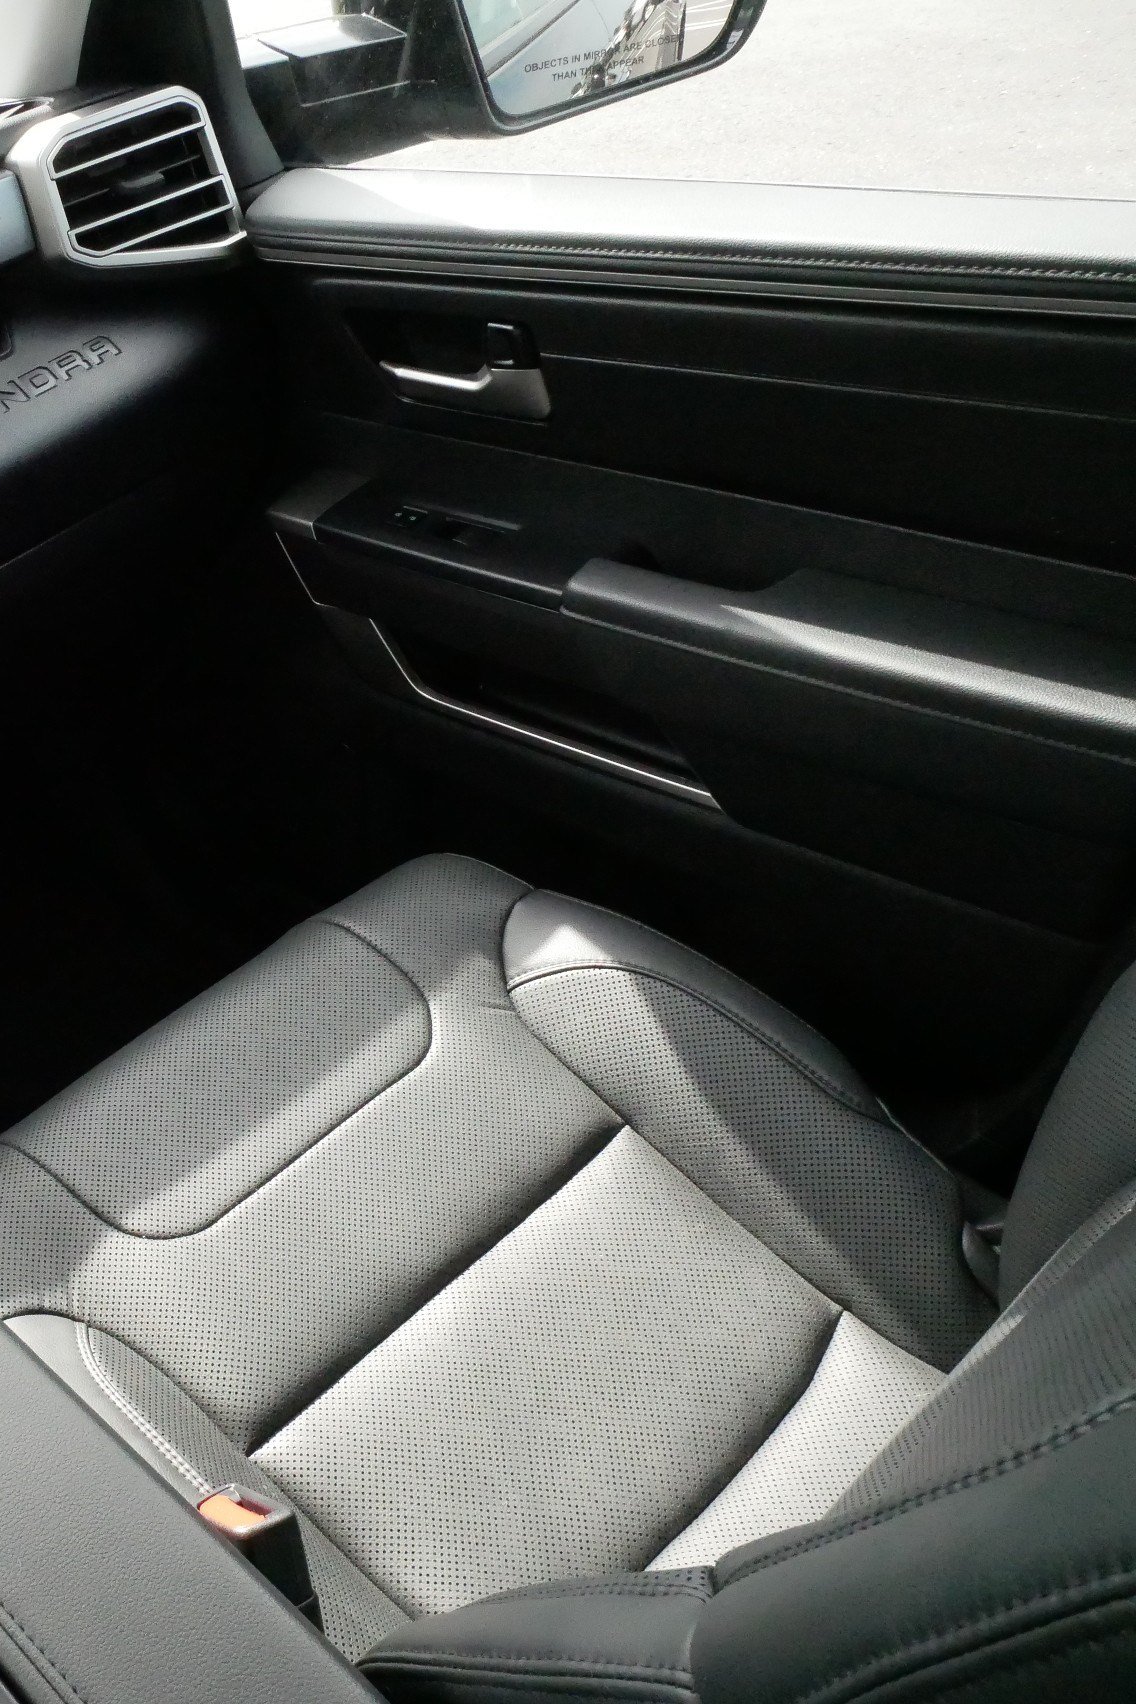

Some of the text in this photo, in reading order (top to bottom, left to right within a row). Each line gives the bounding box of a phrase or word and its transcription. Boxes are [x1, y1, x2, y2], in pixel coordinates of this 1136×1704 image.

[524, 53, 569, 73] OBJECTS
[572, 51, 581, 64] IN
[624, 39, 643, 51] ARE
[552, 70, 577, 82] THAN
[607, 55, 645, 70] APPEAR
